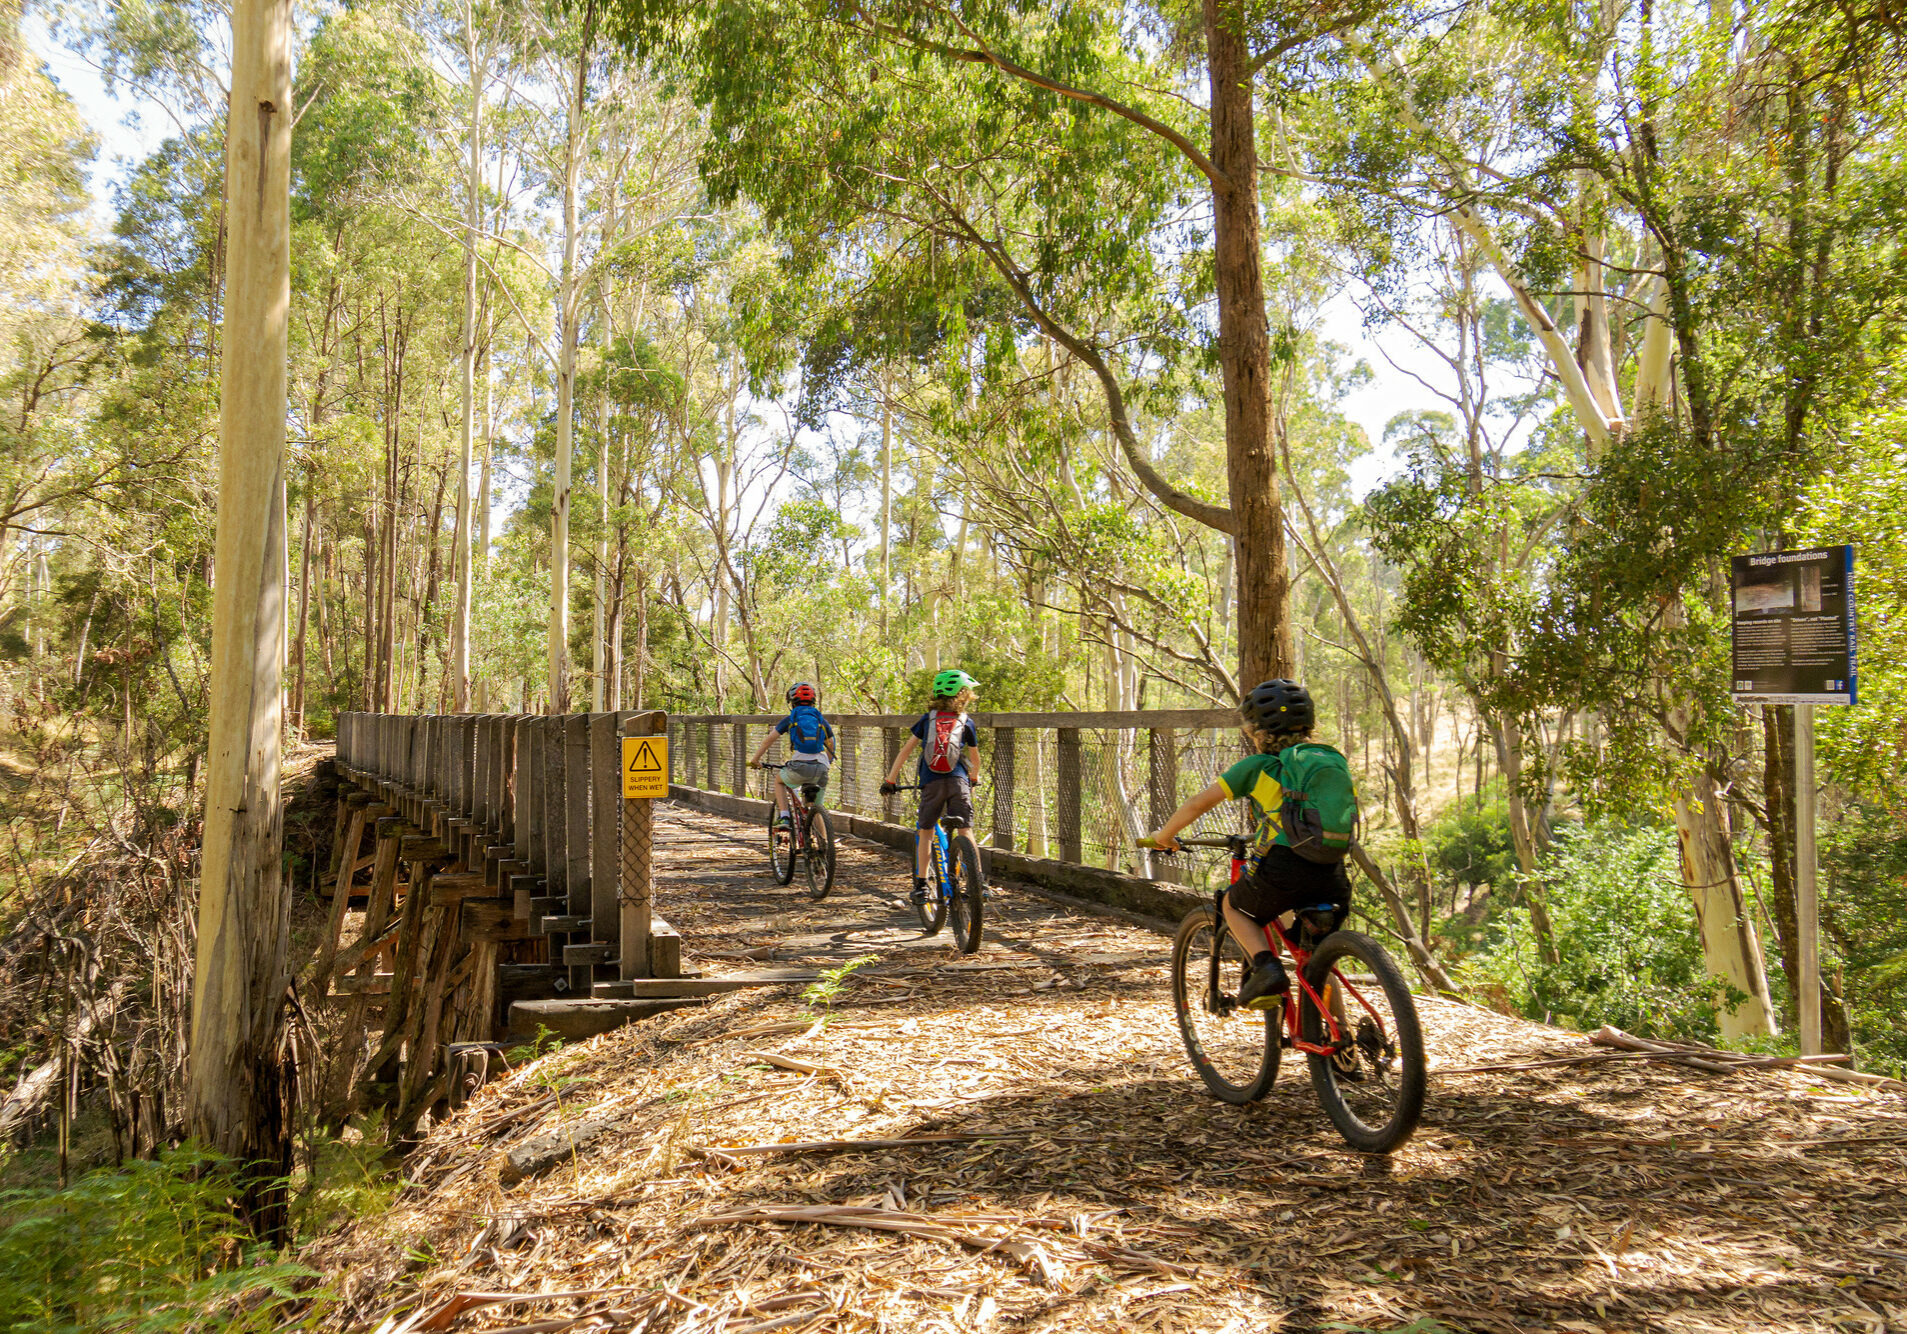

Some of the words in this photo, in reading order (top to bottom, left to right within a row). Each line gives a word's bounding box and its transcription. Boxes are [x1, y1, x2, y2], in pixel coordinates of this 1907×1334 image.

[1750, 556, 1777, 567] Bridge
[1778, 551, 1828, 563] foundations
[1847, 572, 1855, 592] HIGH
[1848, 594, 1856, 633] COUNTRY
[1849, 634, 1857, 653] RAIL
[1849, 655, 1857, 678] TRAIL
